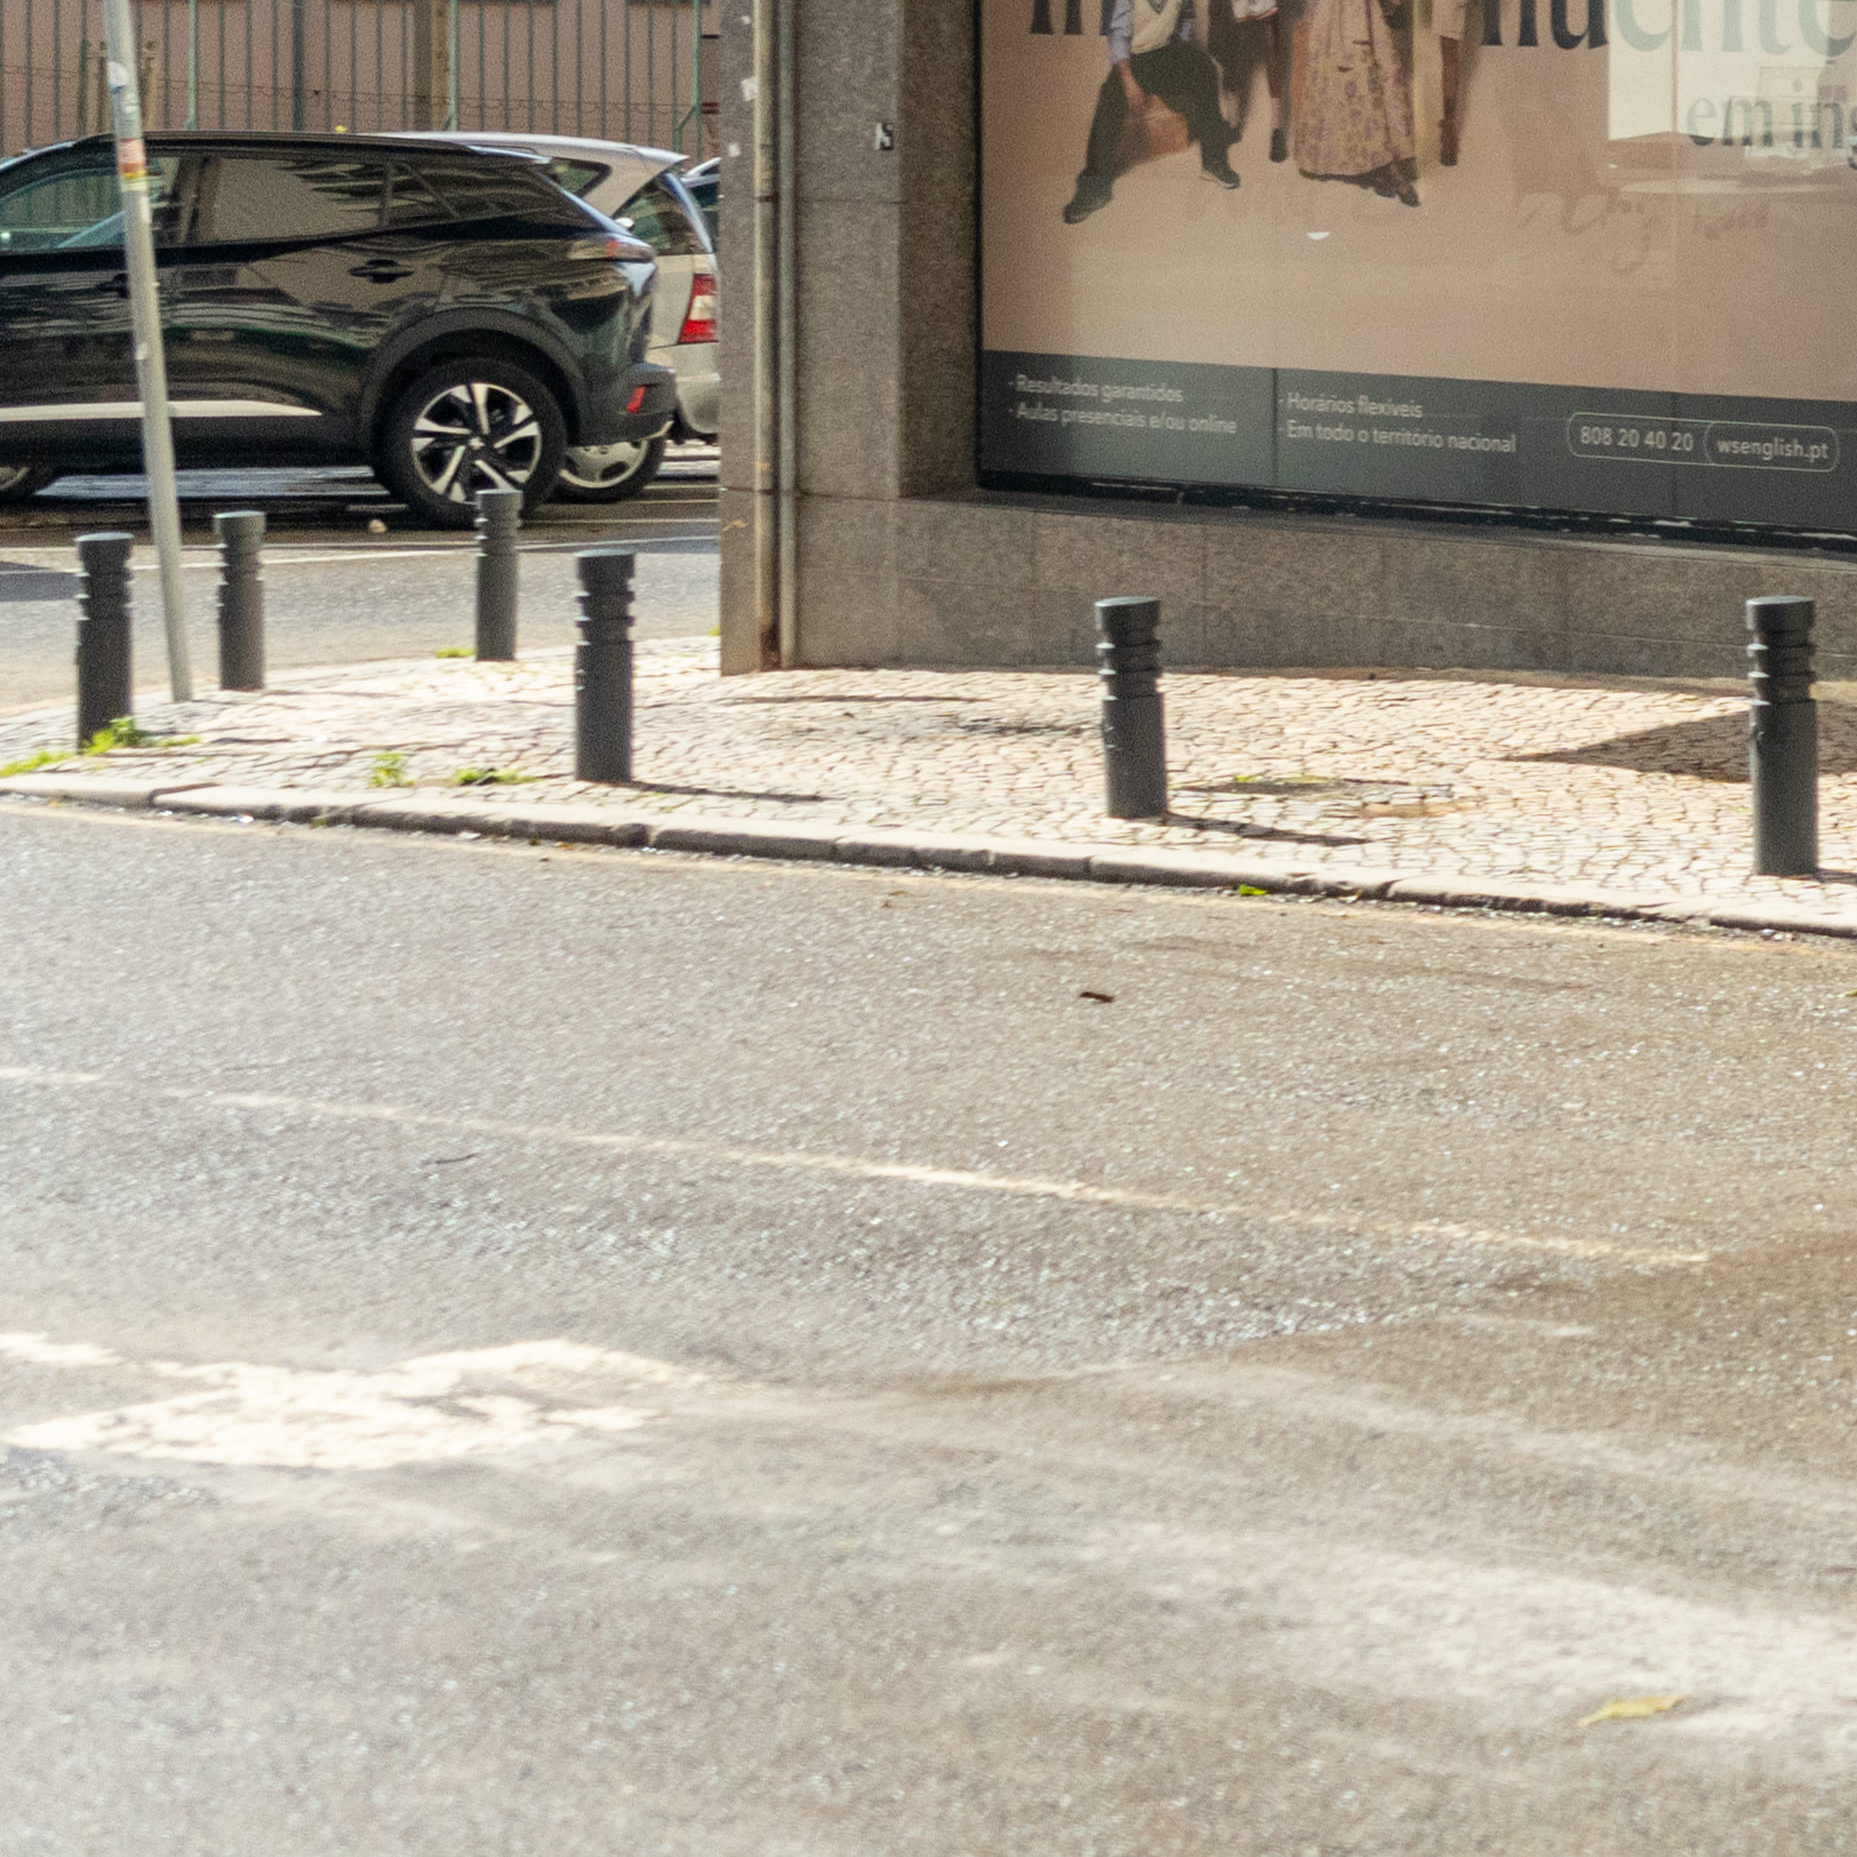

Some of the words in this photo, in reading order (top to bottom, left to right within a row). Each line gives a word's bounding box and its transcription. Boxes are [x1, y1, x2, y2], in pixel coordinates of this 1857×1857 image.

[1687, 94, 1775, 147] em
[1101, 381, 1184, 403] garantidos
[1061, 408, 1147, 428] presenciais
[1188, 414, 1238, 434] online
[1286, 418, 1314, 440] Em
[1315, 422, 1355, 442] todo
[1359, 428, 1370, 443] o
[1372, 427, 1444, 448] território
[1448, 432, 1517, 453] nacional
[1580, 426, 1613, 446] 808
[1617, 428, 1640, 448] 20
[1643, 430, 1667, 450] 40
[1671, 432, 1694, 452] 20
[1717, 436, 1829, 463] wsenglish.pt
